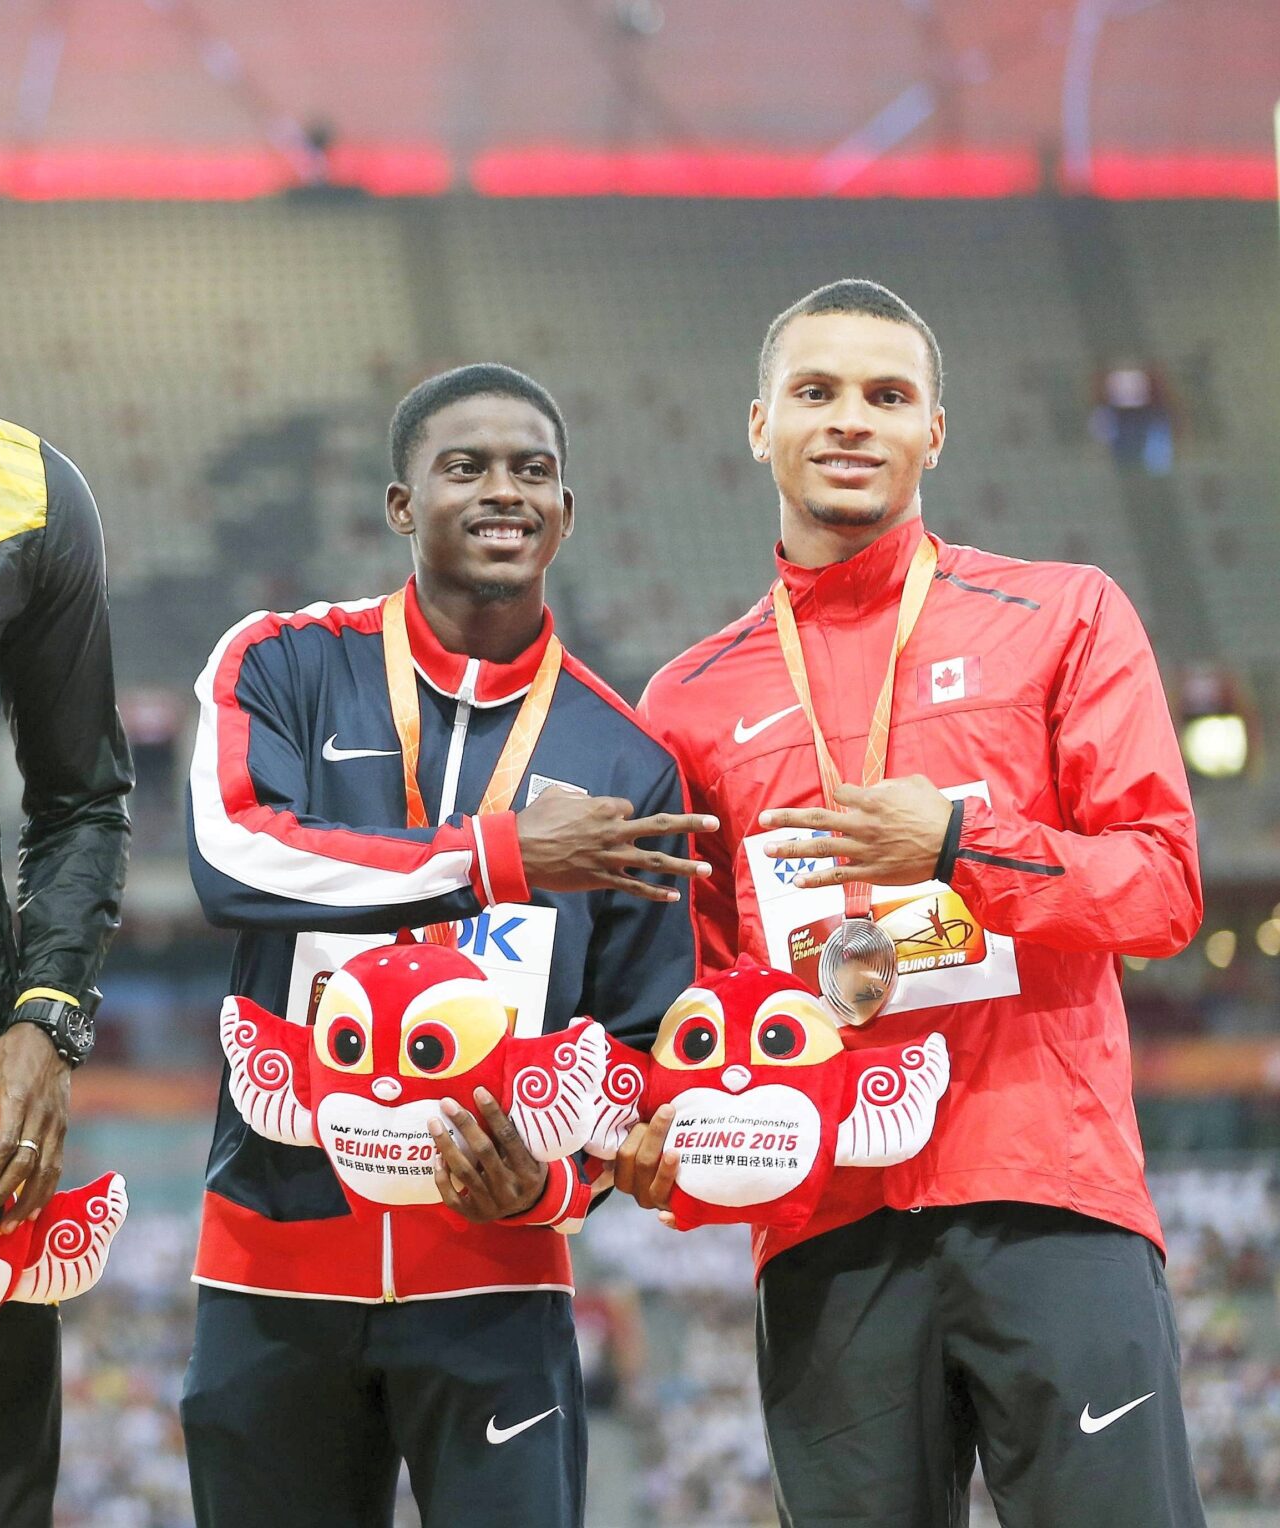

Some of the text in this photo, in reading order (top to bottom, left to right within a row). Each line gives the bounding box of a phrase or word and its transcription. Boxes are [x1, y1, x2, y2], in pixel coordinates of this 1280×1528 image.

[792, 936, 815, 952] World
[793, 942, 826, 961] Champio
[897, 951, 967, 973] EIJING 2015
[676, 1115, 800, 1129] IAAF World Championships
[330, 1123, 454, 1141] IAAF World Champions
[674, 1131, 799, 1151] BEIJING 2015
[334, 1137, 440, 1161] BEIJING 20
[336, 1155, 435, 1176] 国际田联世界田径锦
[680, 1153, 799, 1170] 际田联世界田径锦标赛
